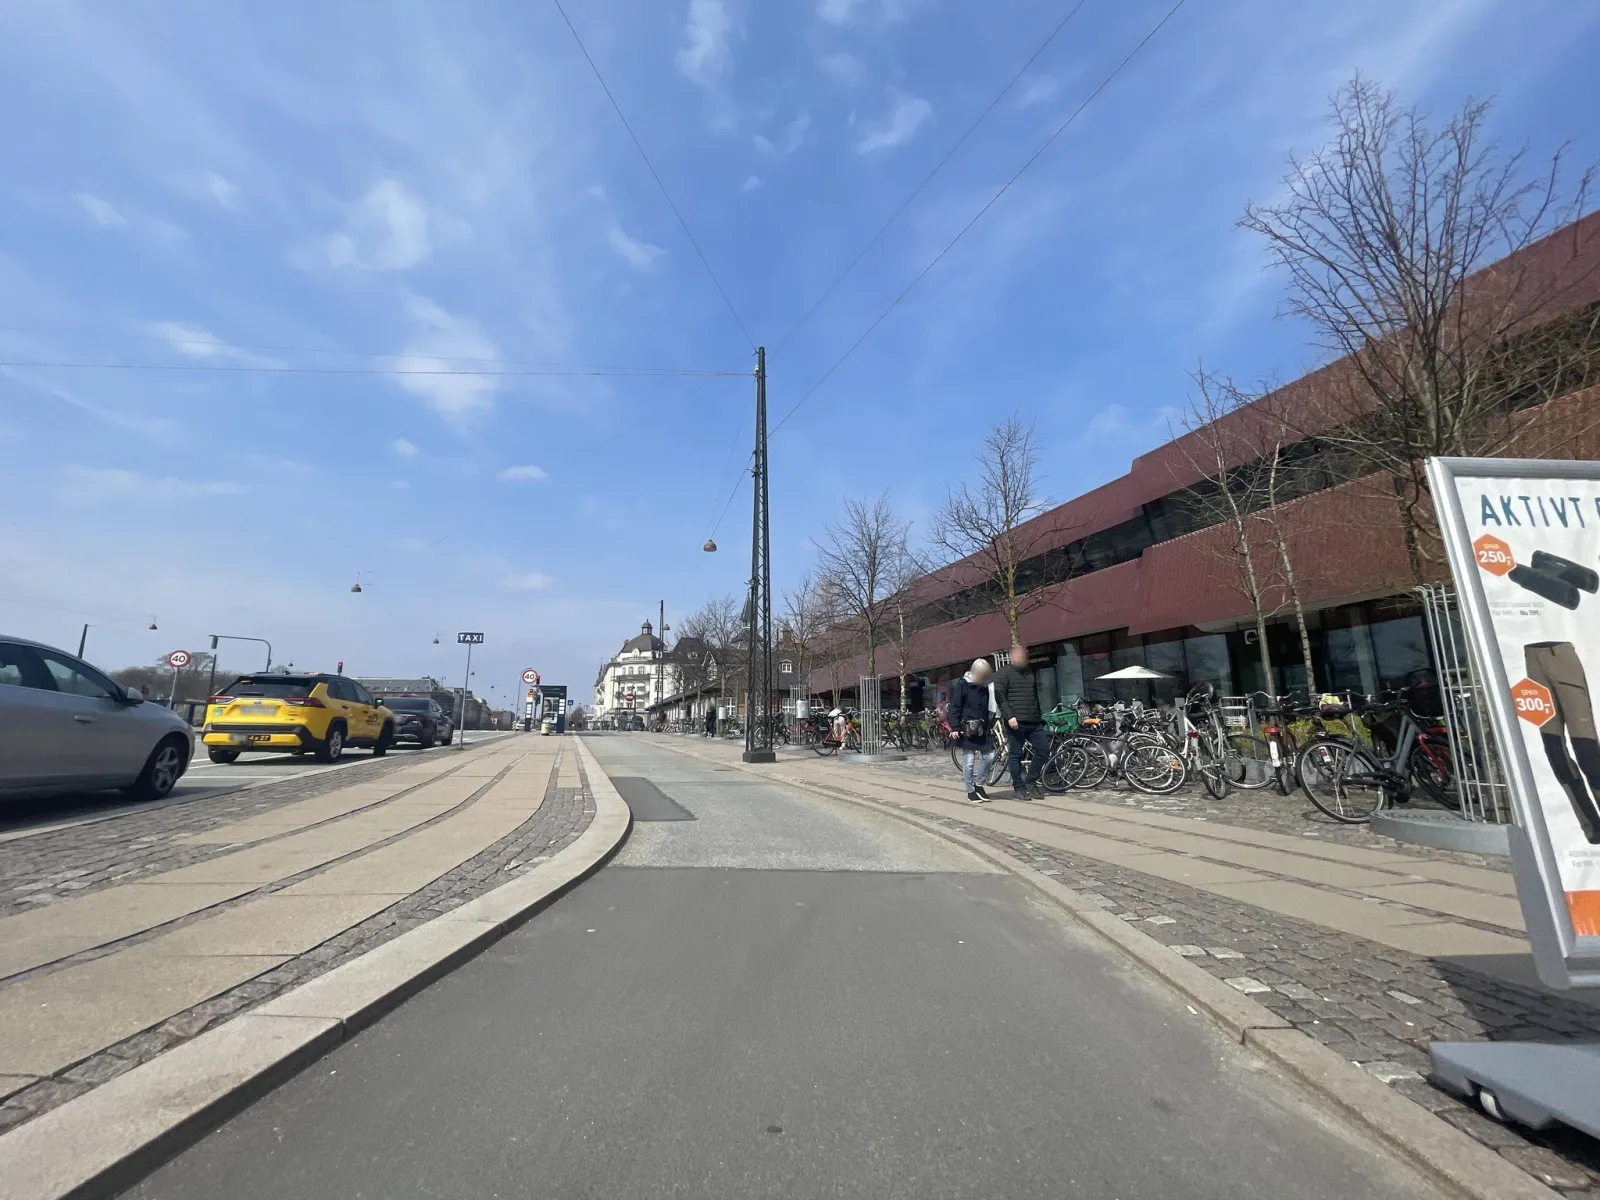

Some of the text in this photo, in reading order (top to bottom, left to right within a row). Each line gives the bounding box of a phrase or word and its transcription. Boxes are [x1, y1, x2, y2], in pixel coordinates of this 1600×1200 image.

[1480, 494, 1585, 528] AKTIVT
[459, 634, 483, 642] TAXI
[171, 655, 186, 663] 40
